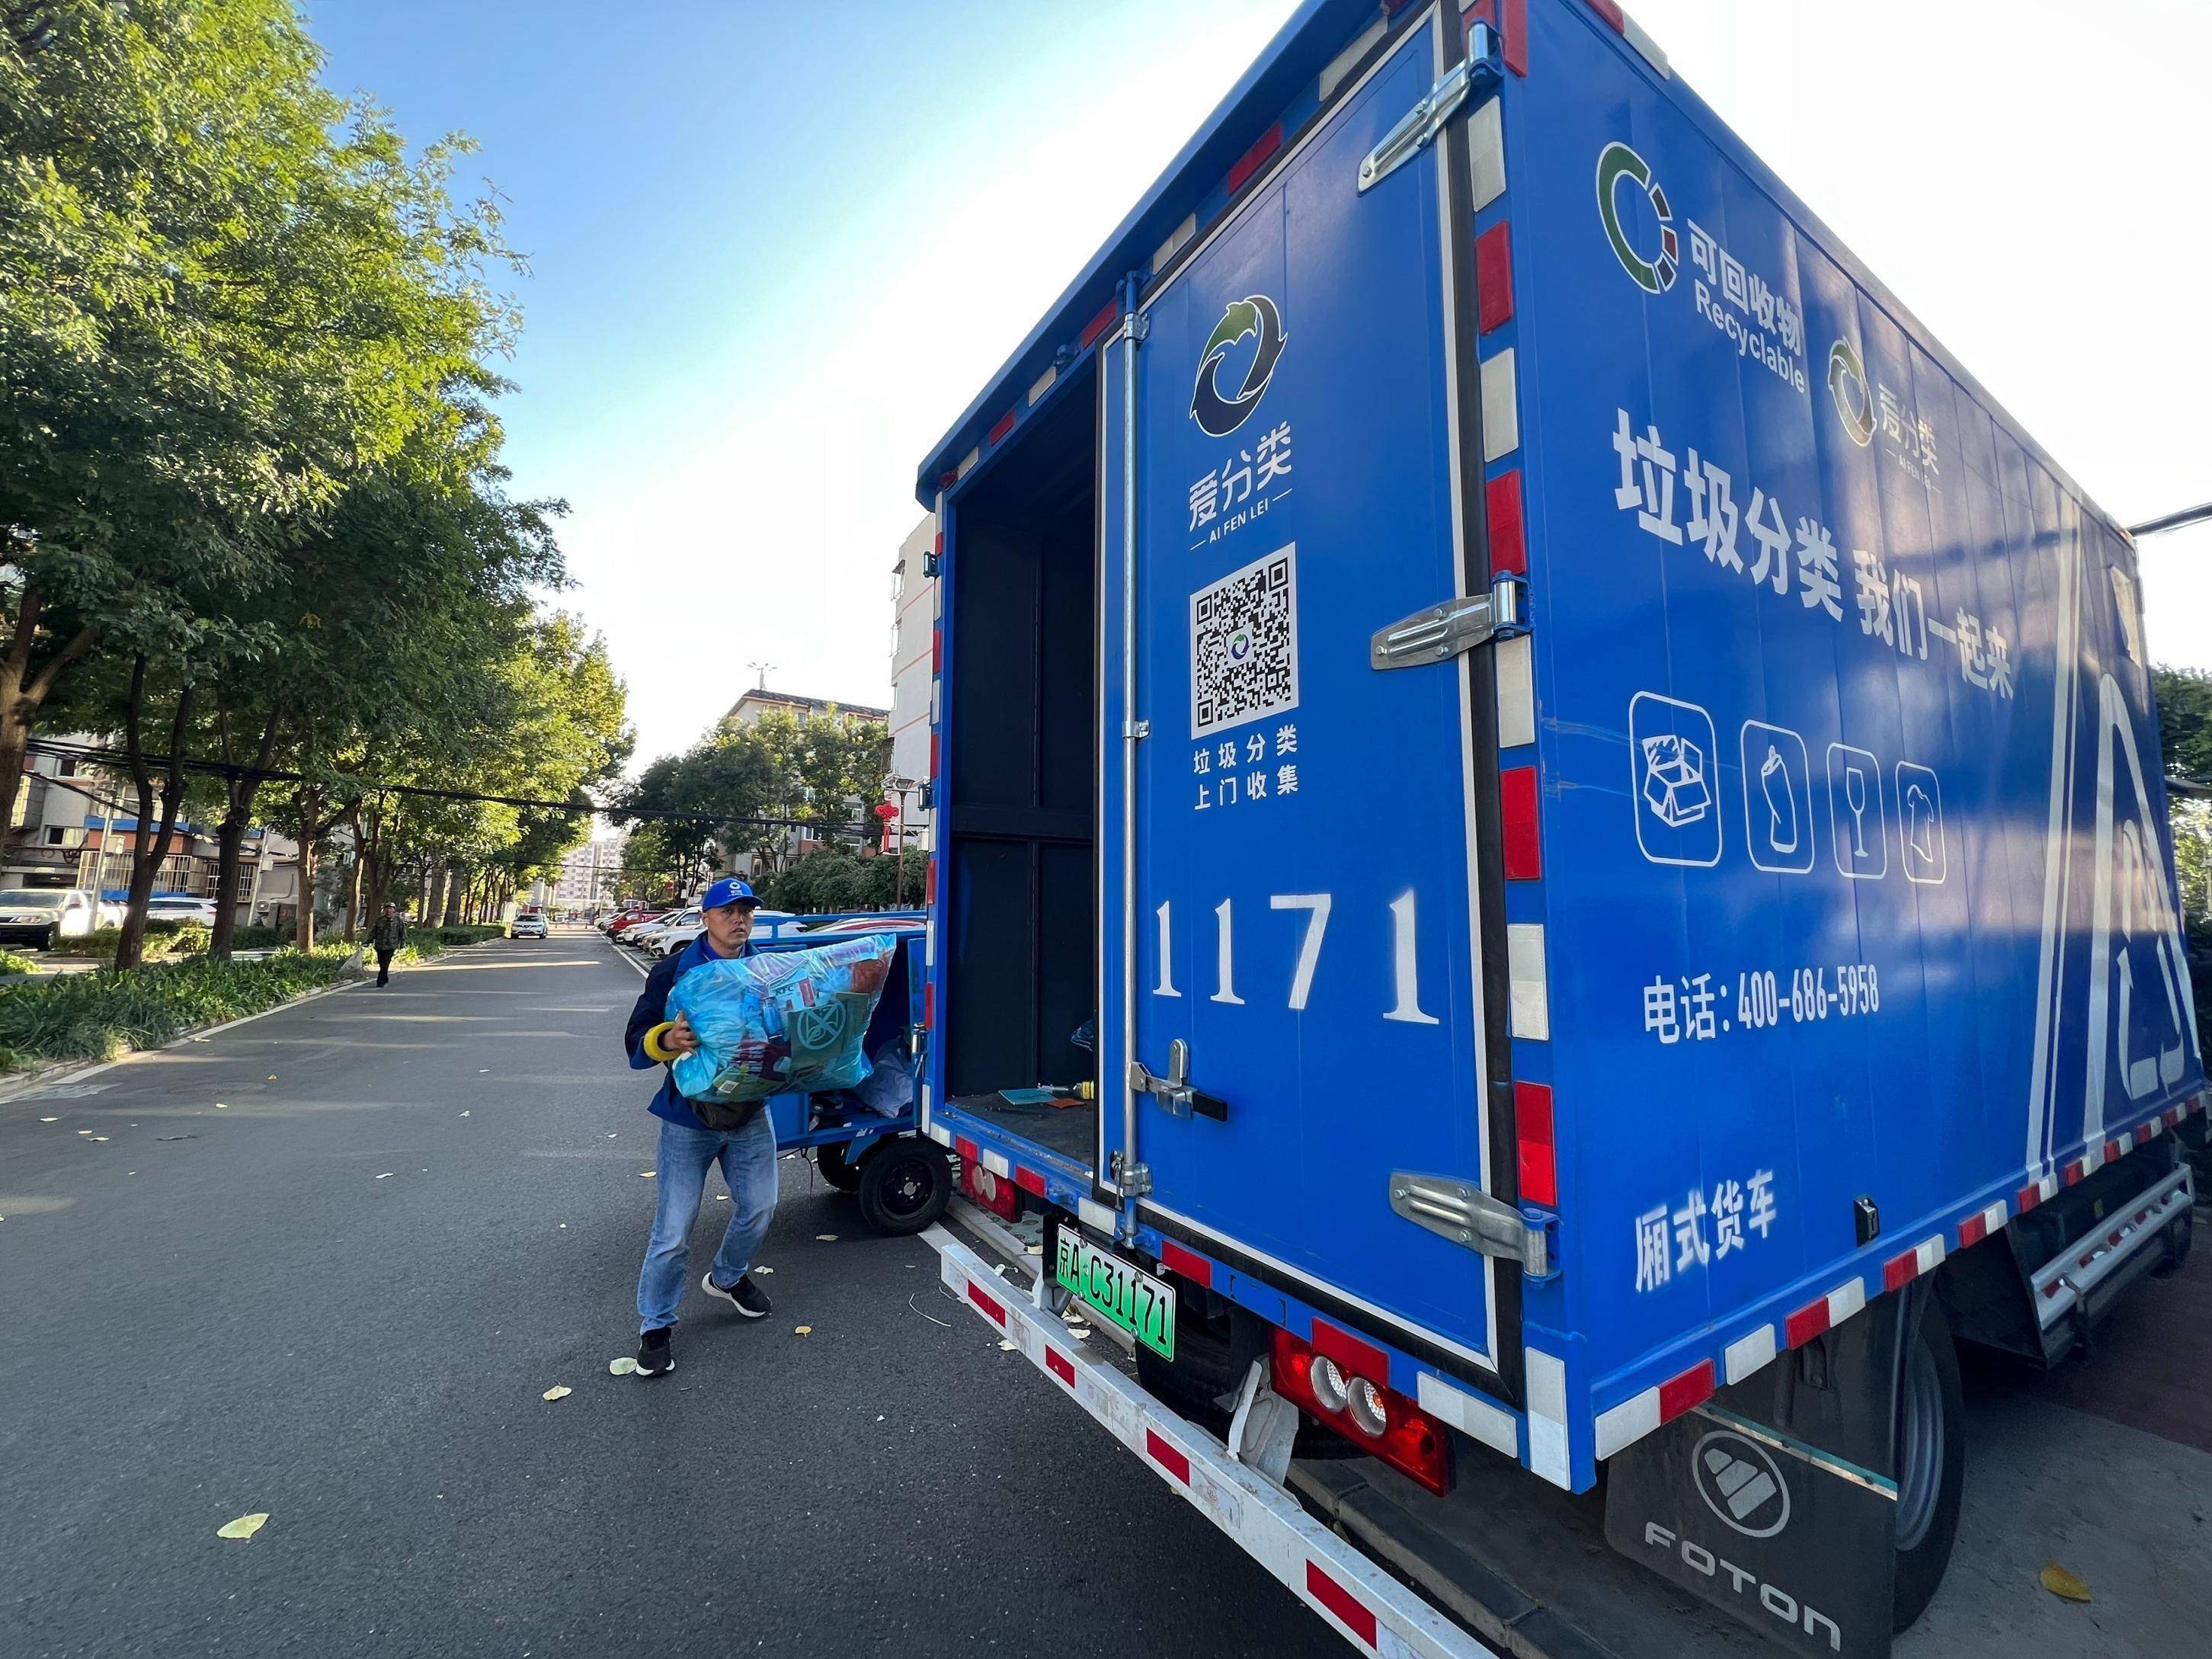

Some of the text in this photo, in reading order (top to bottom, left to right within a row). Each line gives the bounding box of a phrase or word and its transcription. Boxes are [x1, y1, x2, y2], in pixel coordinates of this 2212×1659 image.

[1687, 218, 1801, 357] 可回收物
[1695, 278, 1805, 393] Recyclable
[1189, 420, 1292, 532] 爱分类
[1878, 383, 1939, 476] 爱分类
[1209, 498, 1269, 543] AI FEN LEI
[1612, 407, 2014, 700] 垃圾分类 我们一起来
[1193, 723, 1298, 775] 垃圾分类
[1194, 764, 1298, 810] 上门收集
[1152, 889, 1439, 1025] 1171
[1635, 1168, 1776, 1292] 厢式货车
